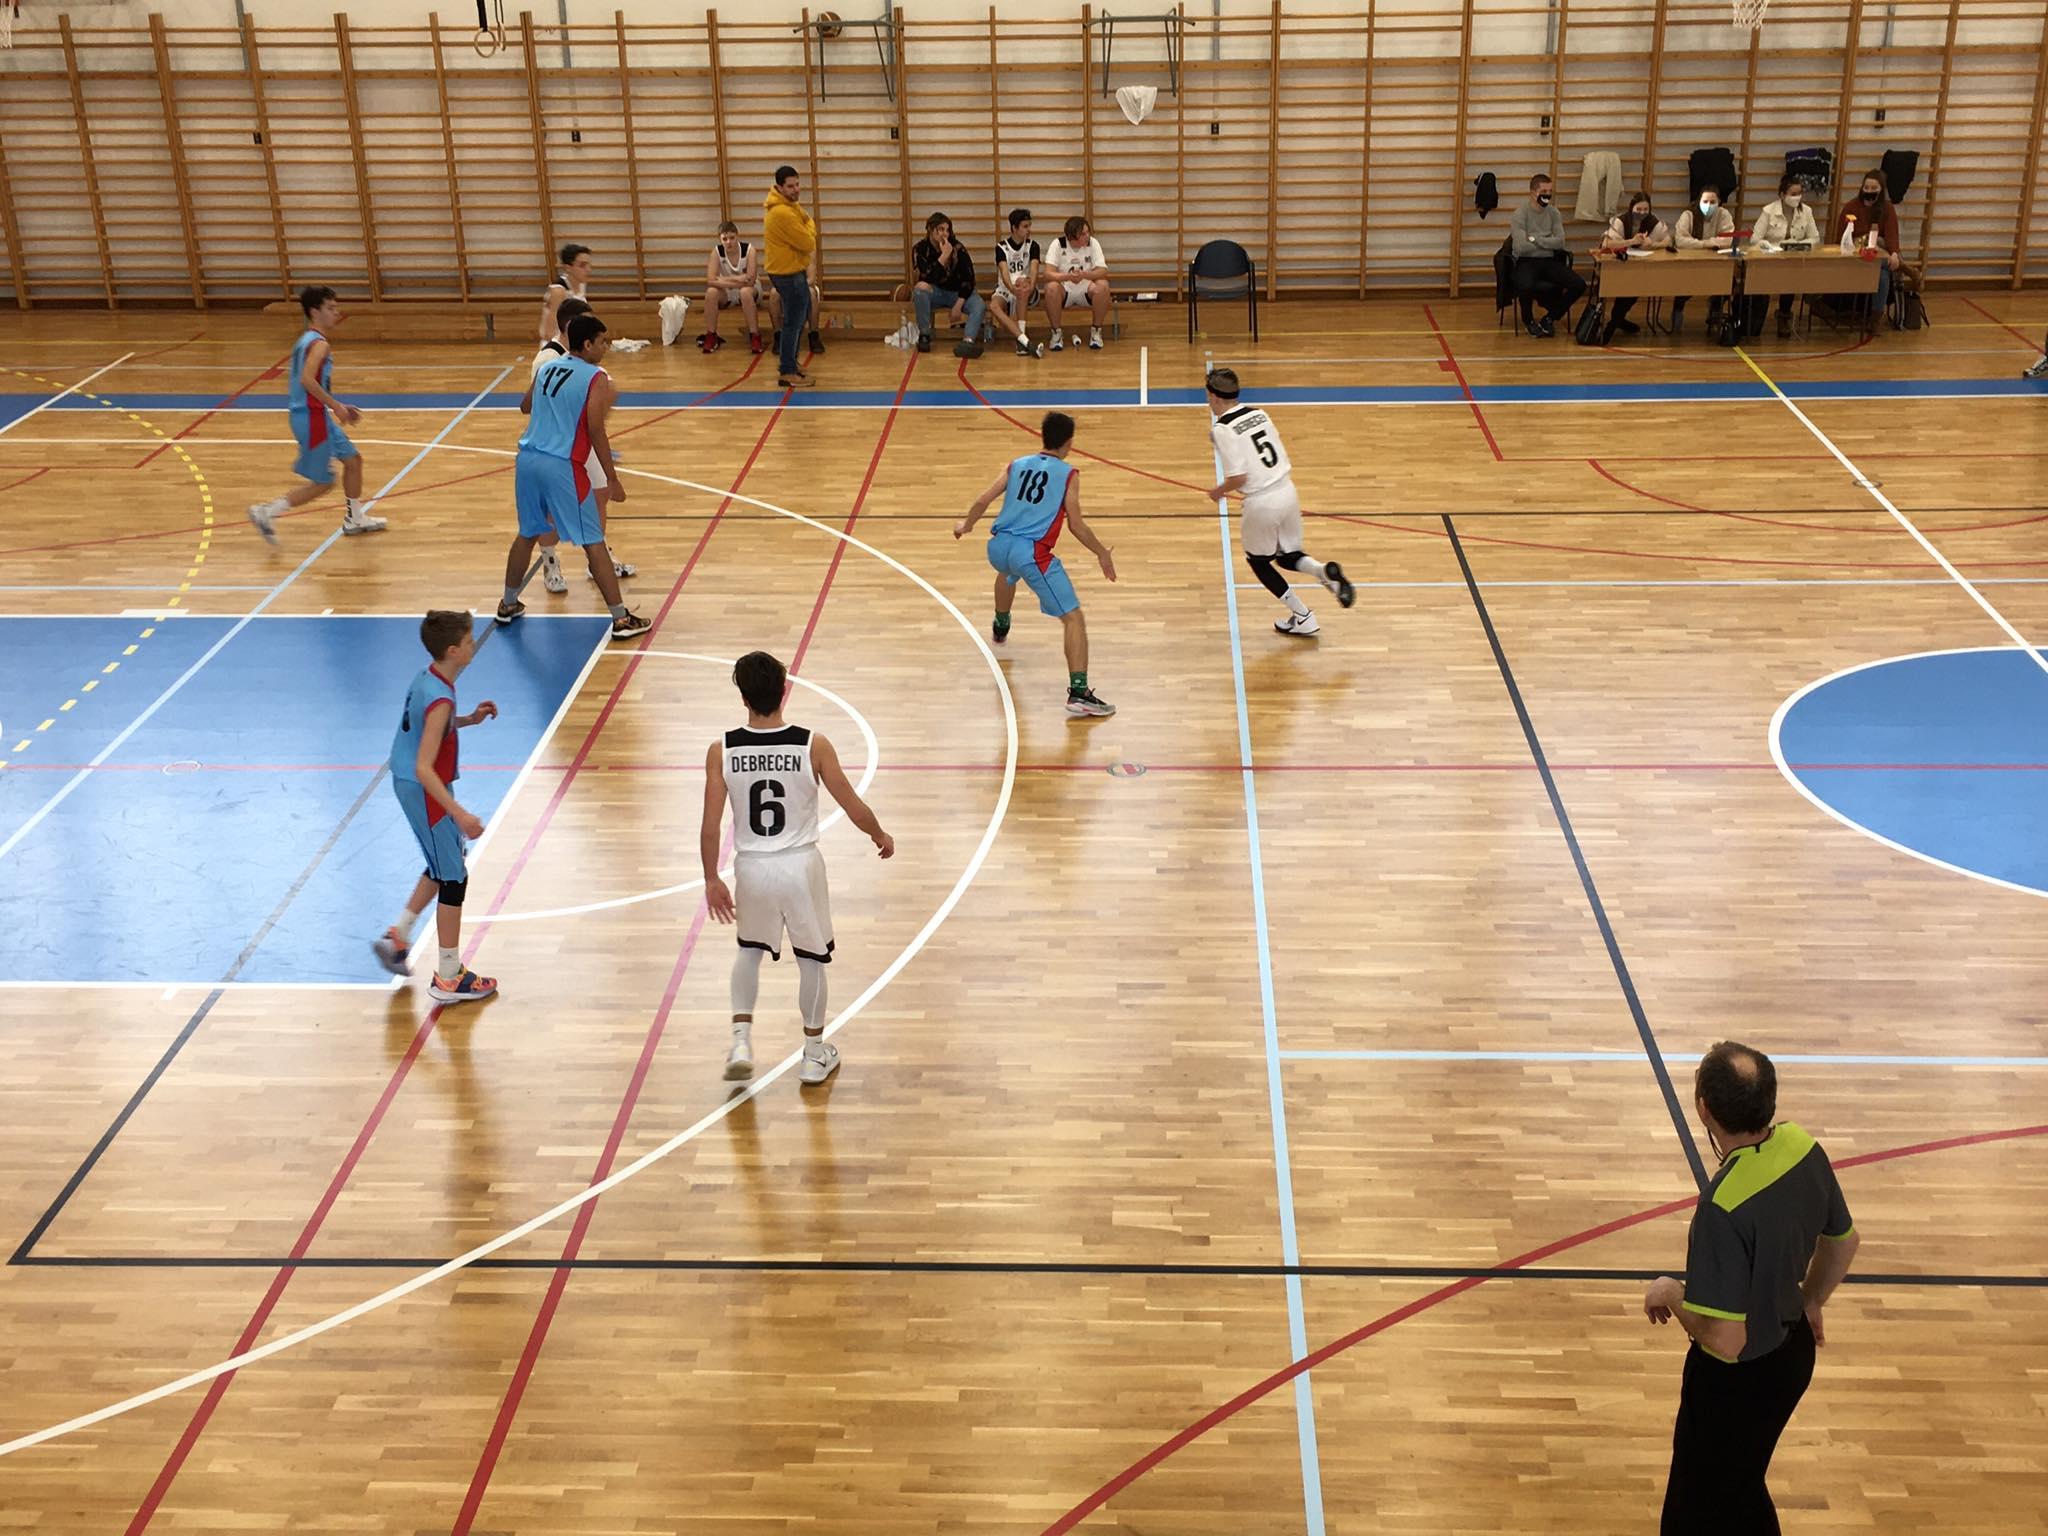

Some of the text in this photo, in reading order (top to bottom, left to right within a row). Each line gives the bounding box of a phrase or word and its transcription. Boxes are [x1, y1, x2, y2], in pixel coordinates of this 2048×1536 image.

[1009, 261, 1024, 273] 36
[542, 366, 574, 398] 17
[1250, 430, 1279, 468] 5
[1017, 469, 1049, 504] 18
[731, 754, 802, 773] DEBRECEN
[749, 779, 786, 837] 6
